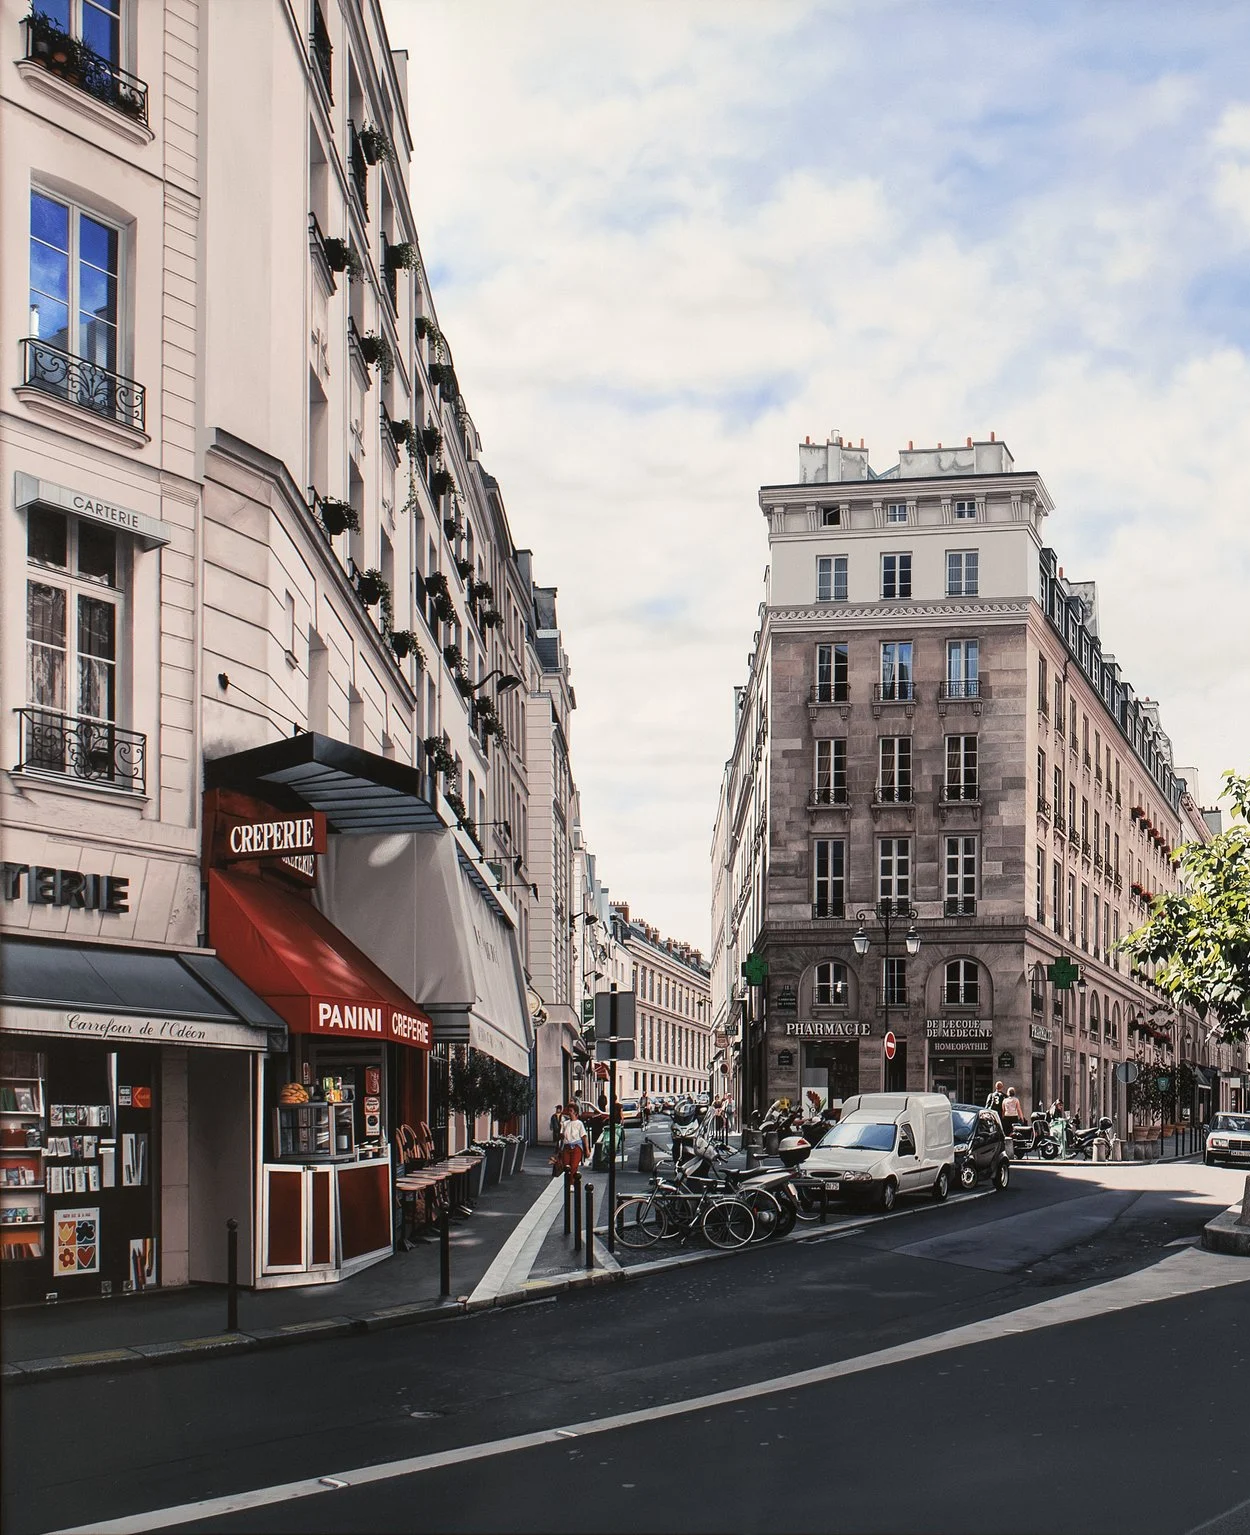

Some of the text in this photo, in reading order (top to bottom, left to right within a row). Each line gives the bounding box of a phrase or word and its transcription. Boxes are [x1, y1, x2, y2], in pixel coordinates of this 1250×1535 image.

[73, 496, 138, 528] CARTERIE
[230, 819, 314, 853] CREPERIE
[1, 861, 129, 913] TERIE
[67, 1013, 206, 1039] Carrefour de l'Odéon
[318, 1002, 429, 1043] PANINI CREPERIE
[786, 1023, 871, 1036] PHARMACIE
[926, 1020, 938, 1028] DE
[926, 1029, 992, 1037] DE MEDECINE
[934, 1042, 988, 1051] HOMEOPATHIE
